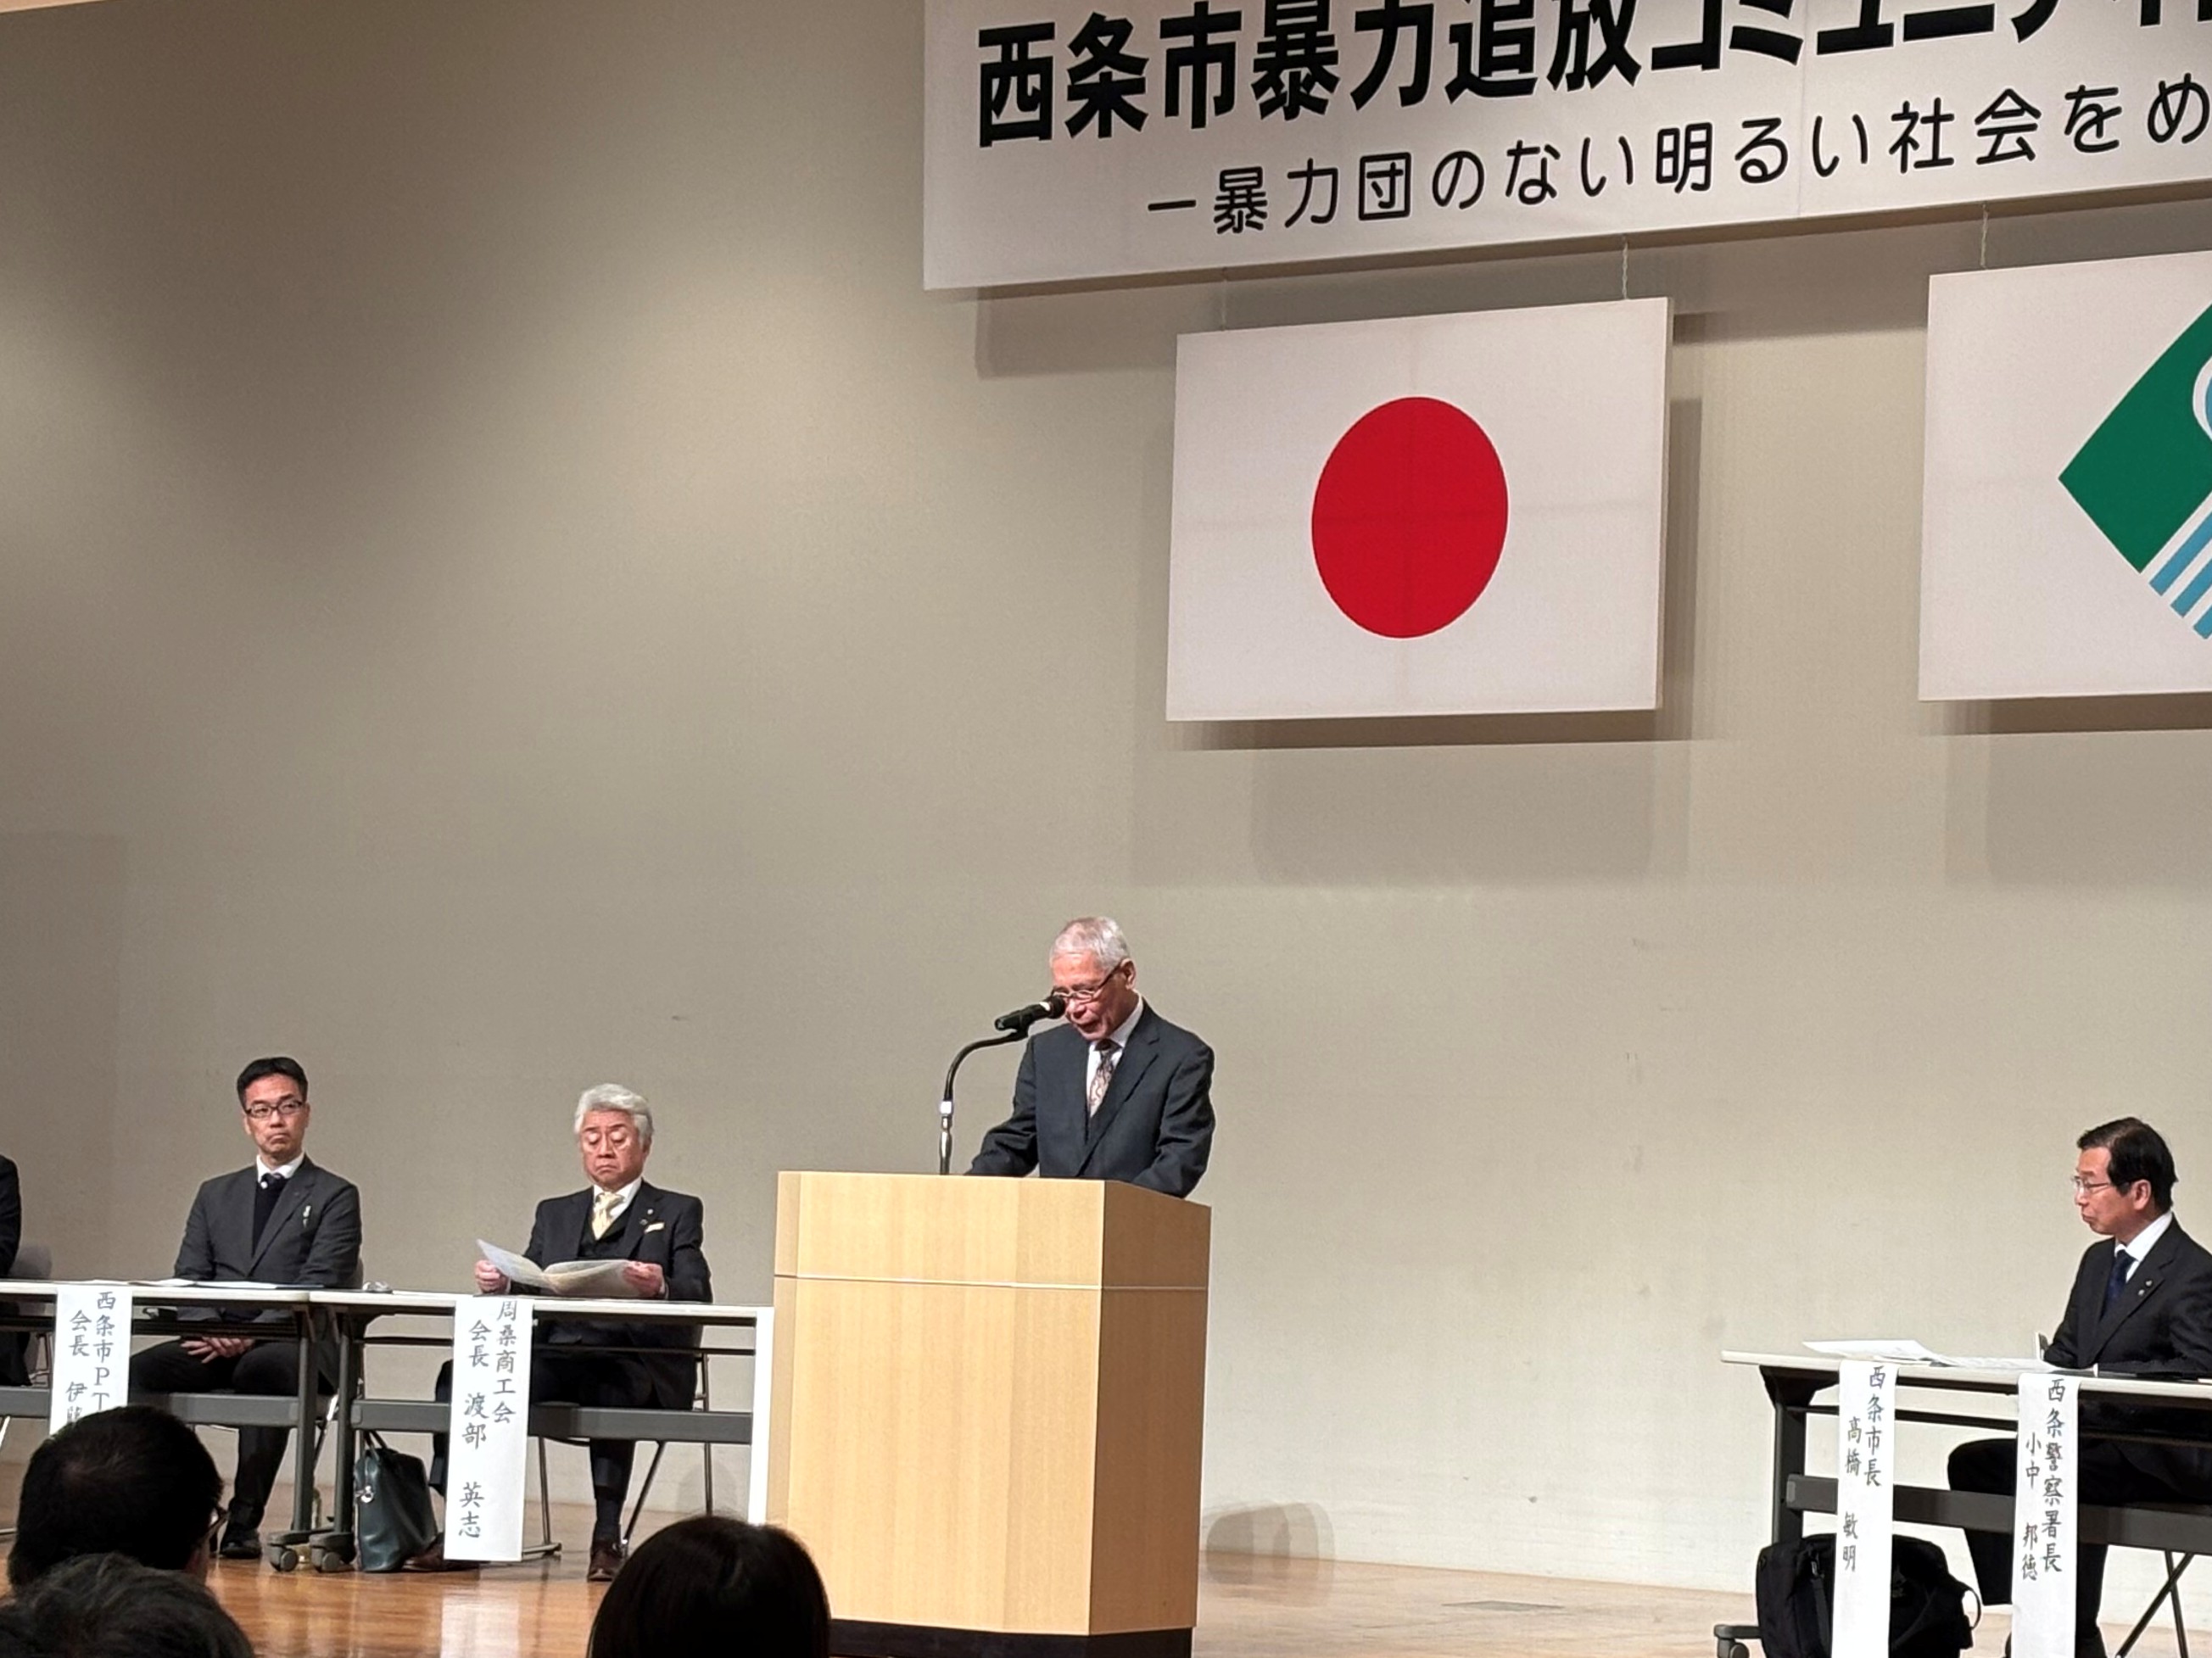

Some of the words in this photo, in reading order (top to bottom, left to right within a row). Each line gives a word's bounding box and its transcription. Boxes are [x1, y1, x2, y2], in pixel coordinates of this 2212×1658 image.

[69, 1309, 92, 1357] 会長
[468, 1319, 492, 1368] 会長
[493, 1300, 517, 1424] 周桑商工会
[462, 1392, 489, 1449] 渡部
[1863, 1365, 1886, 1488] 西条市長
[2025, 1432, 2042, 1488] 小中
[2040, 1378, 2066, 1572] 西条警察署長
[458, 1481, 485, 1538] 英志
[1842, 1511, 1858, 1572] 敏明
